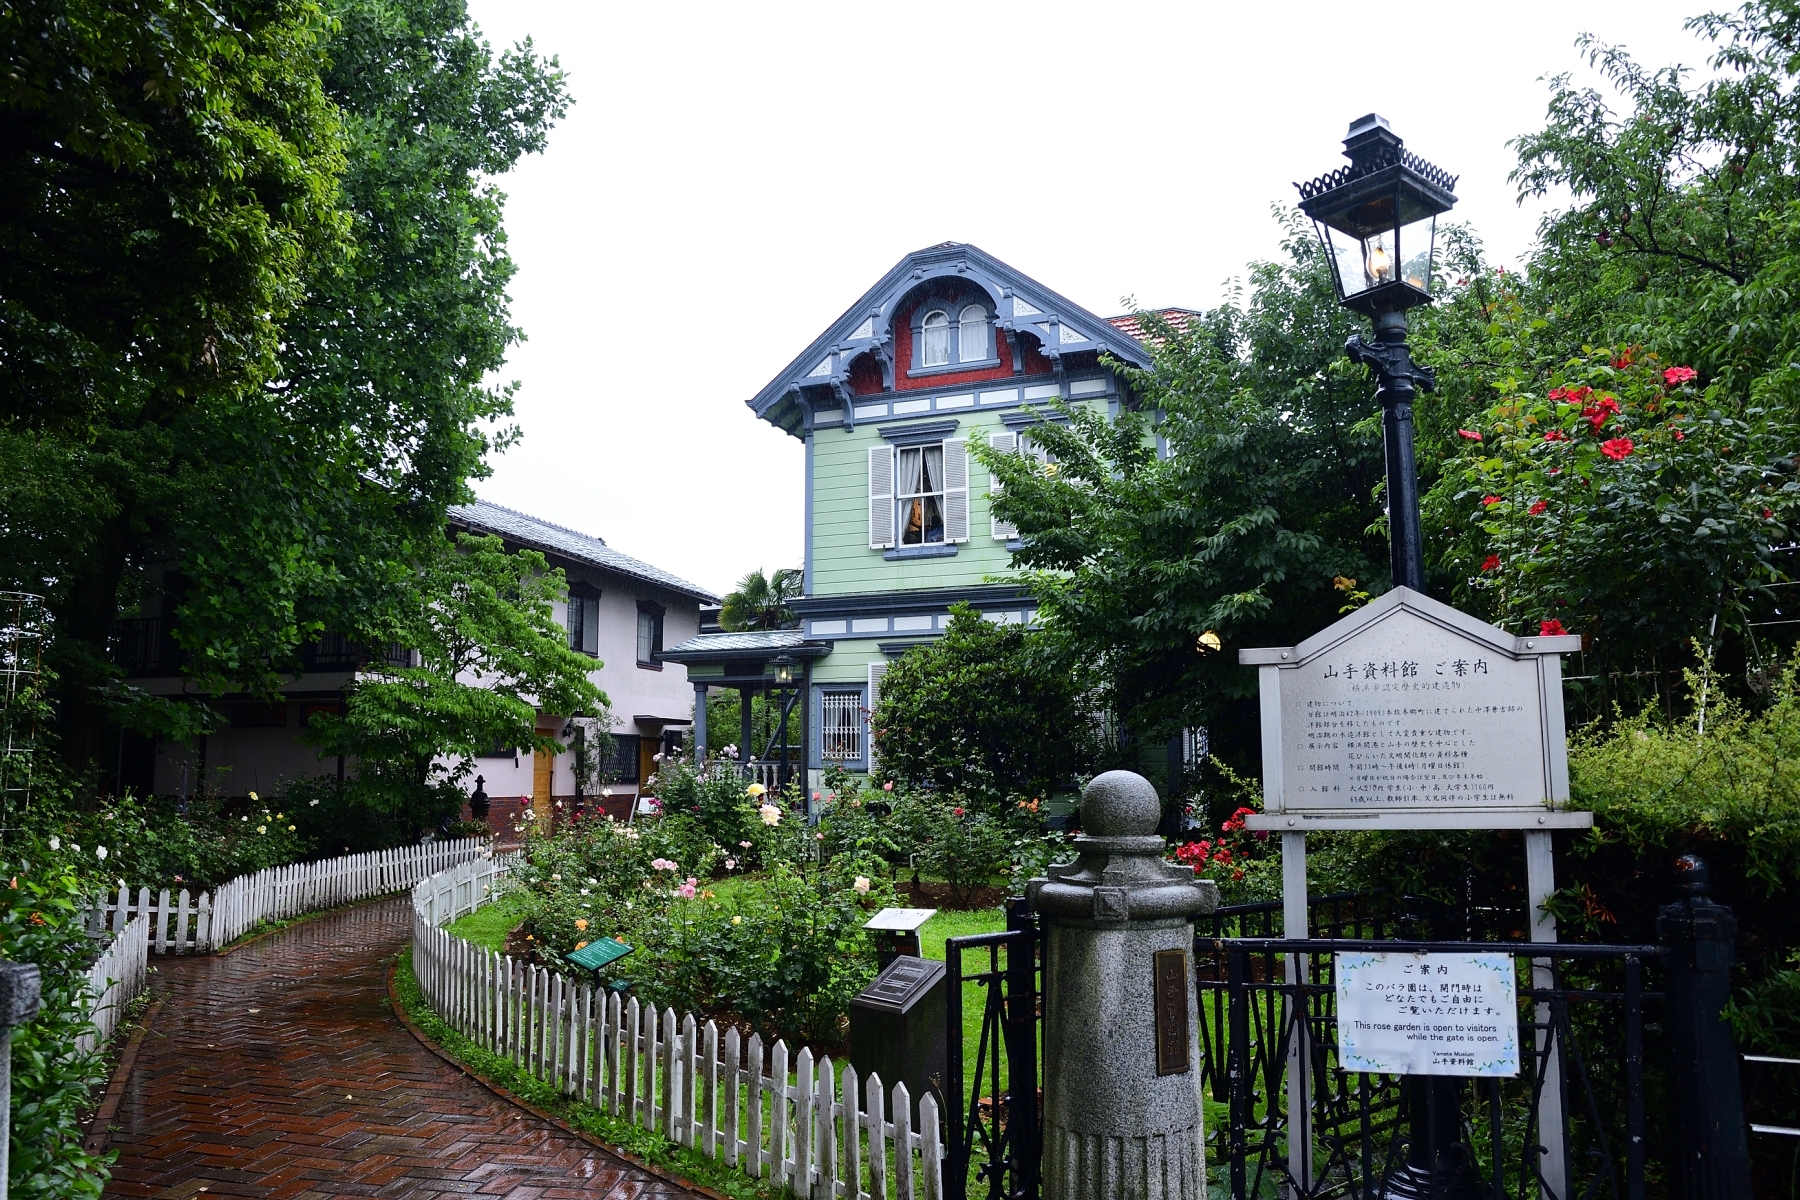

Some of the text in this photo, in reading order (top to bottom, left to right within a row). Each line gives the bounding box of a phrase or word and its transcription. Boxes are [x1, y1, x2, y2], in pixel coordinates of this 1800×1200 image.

[1324, 658, 1488, 680] 山手資料館 ご案内
[1308, 742, 1339, 750] 展示内容
[1309, 764, 1340, 772] 開館時間
[1403, 964, 1448, 975] ご案内
[1366, 983, 1482, 993] このバラ園は、開門時は
[1385, 994, 1483, 1004] どなたでもご自由に
[1398, 1006, 1501, 1016] ご覧いただけます。
[1354, 1021, 1371, 1030] This
[1394, 1023, 1421, 1032] garden
[1423, 1023, 1430, 1031] is
[1433, 1025, 1453, 1034] open
[1456, 1024, 1464, 1032] to
[1467, 1024, 1497, 1032] visitors
[1406, 1033, 1500, 1043] while the gate is open.
[1432, 1057, 1474, 1066] 山手資料館
